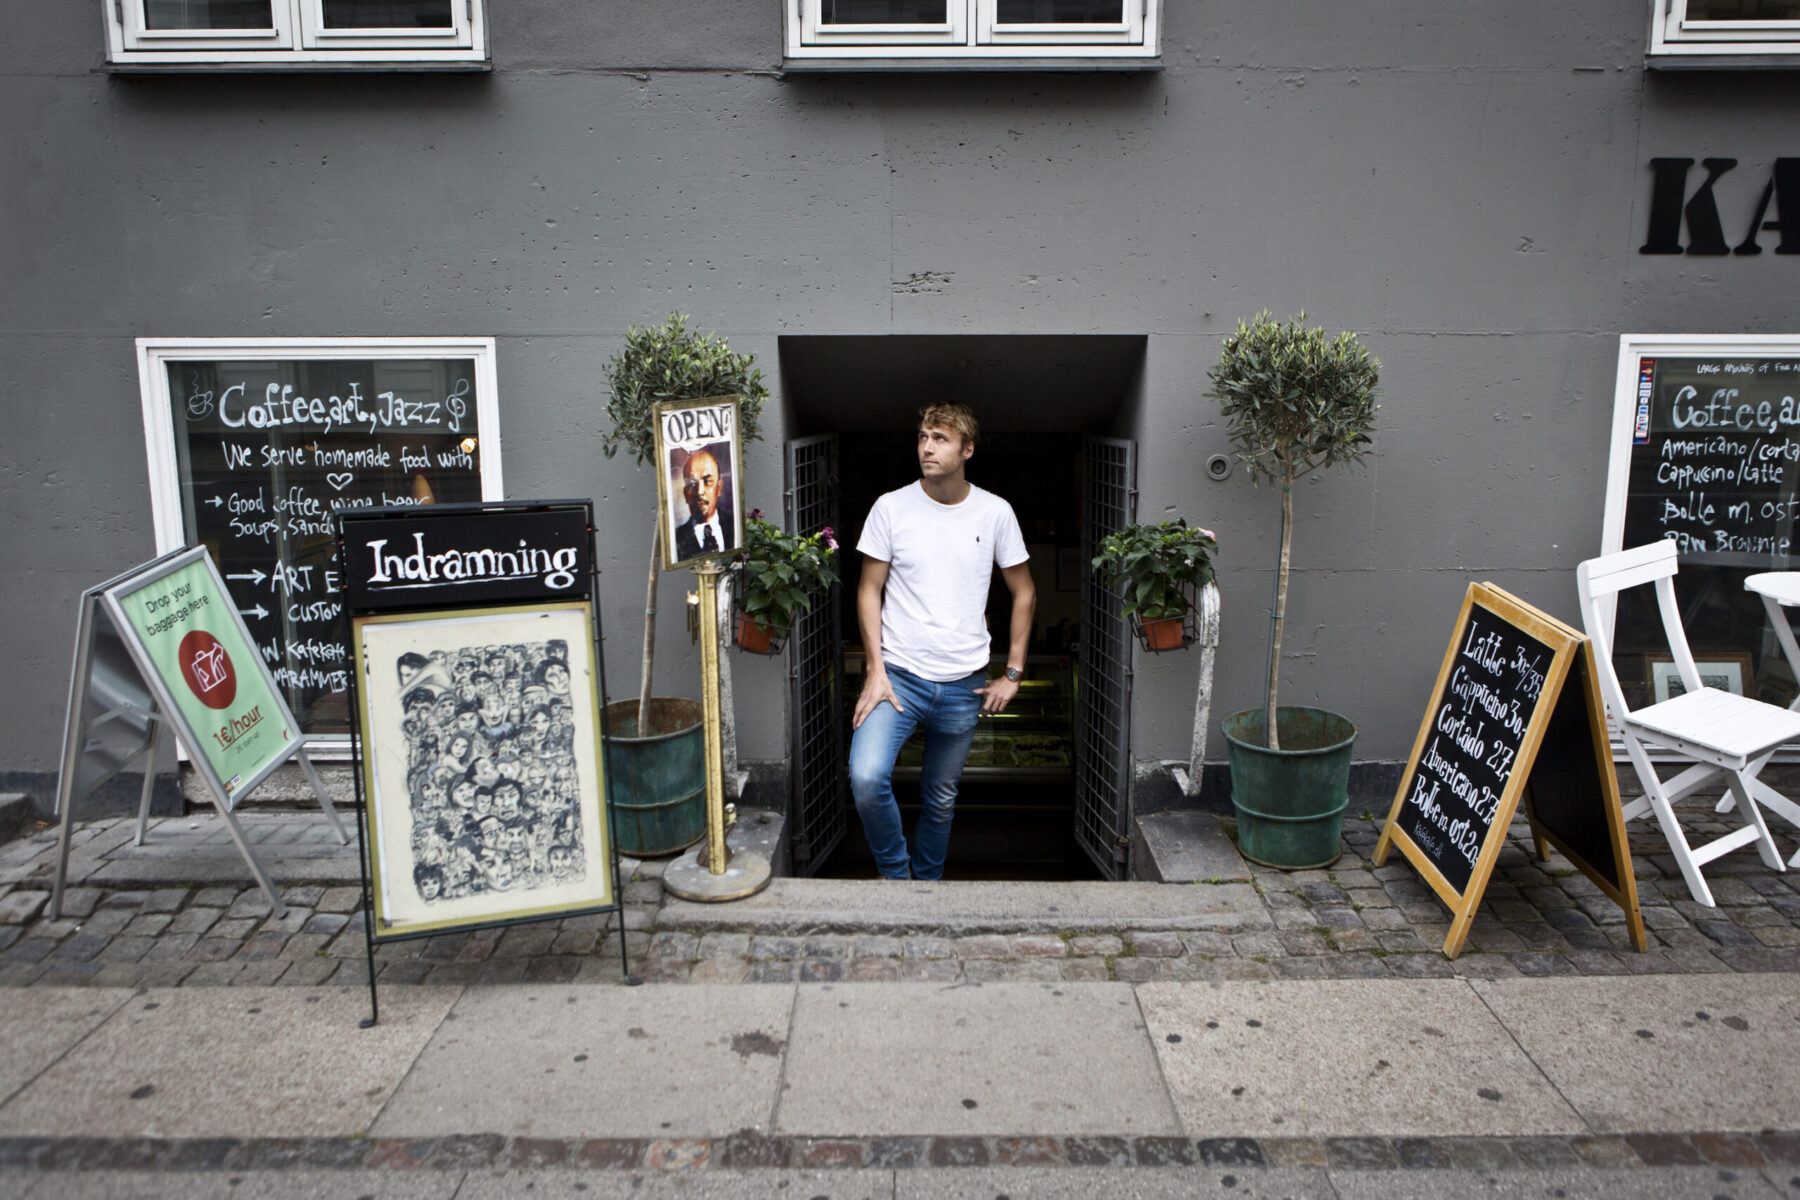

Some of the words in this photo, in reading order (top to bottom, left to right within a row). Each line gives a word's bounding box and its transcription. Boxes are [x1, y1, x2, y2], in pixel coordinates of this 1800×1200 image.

[1638, 157, 1800, 256] KA
[221, 440, 252, 470] We
[261, 444, 306, 467] serve
[314, 440, 391, 468] homemade
[400, 445, 431, 473] food
[437, 445, 473, 470] with
[228, 487, 265, 515] Good
[1660, 491, 1715, 525] Bolle
[271, 559, 313, 597] ART
[366, 532, 579, 589] Indramning
[145, 594, 171, 614] Drop
[171, 582, 192, 603] your
[145, 606, 190, 636] baggage
[187, 595, 209, 612] here
[1463, 620, 1506, 677] Latte
[213, 704, 261, 748] 1€/hour
[1438, 703, 1485, 760] Cortado
[1421, 735, 1478, 809] Americano
